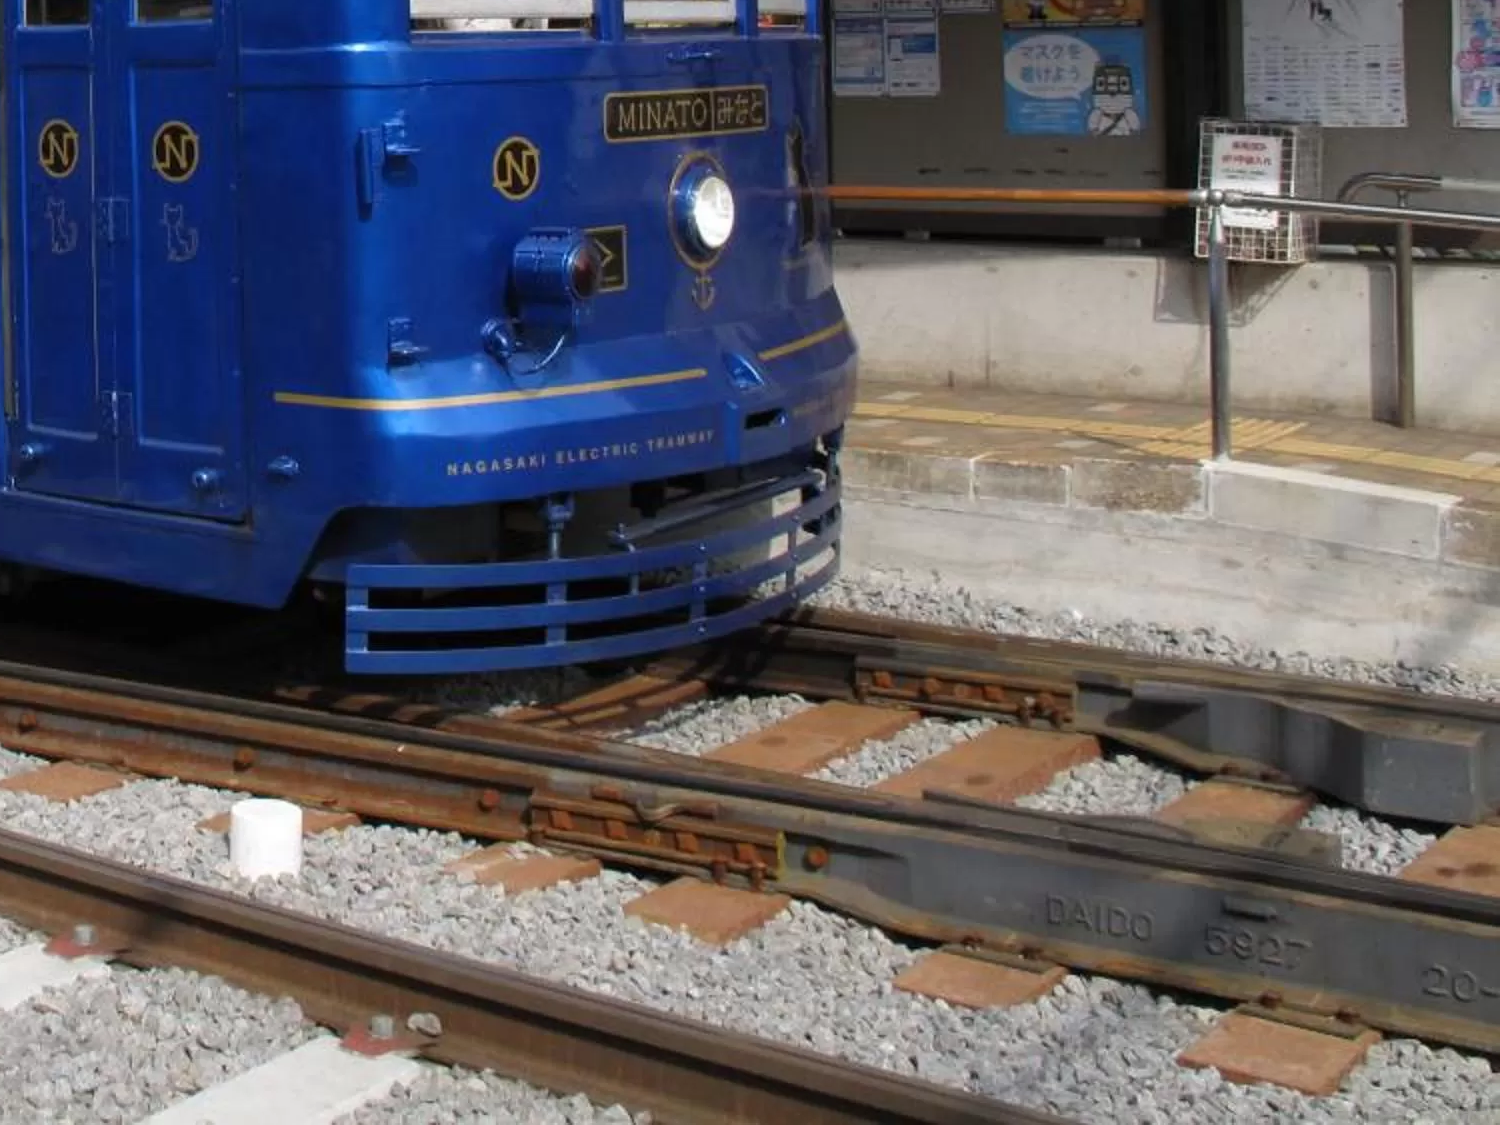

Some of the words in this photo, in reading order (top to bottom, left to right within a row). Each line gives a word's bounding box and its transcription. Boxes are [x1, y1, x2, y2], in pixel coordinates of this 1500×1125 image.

[618, 98, 707, 132] MINATO
[716, 91, 763, 124] みなと
[447, 454, 547, 477] NAGASAKI
[555, 443, 640, 466] ELECTRIC
[647, 429, 716, 453] TRAMWAY
[1045, 894, 1154, 941] DAIDO
